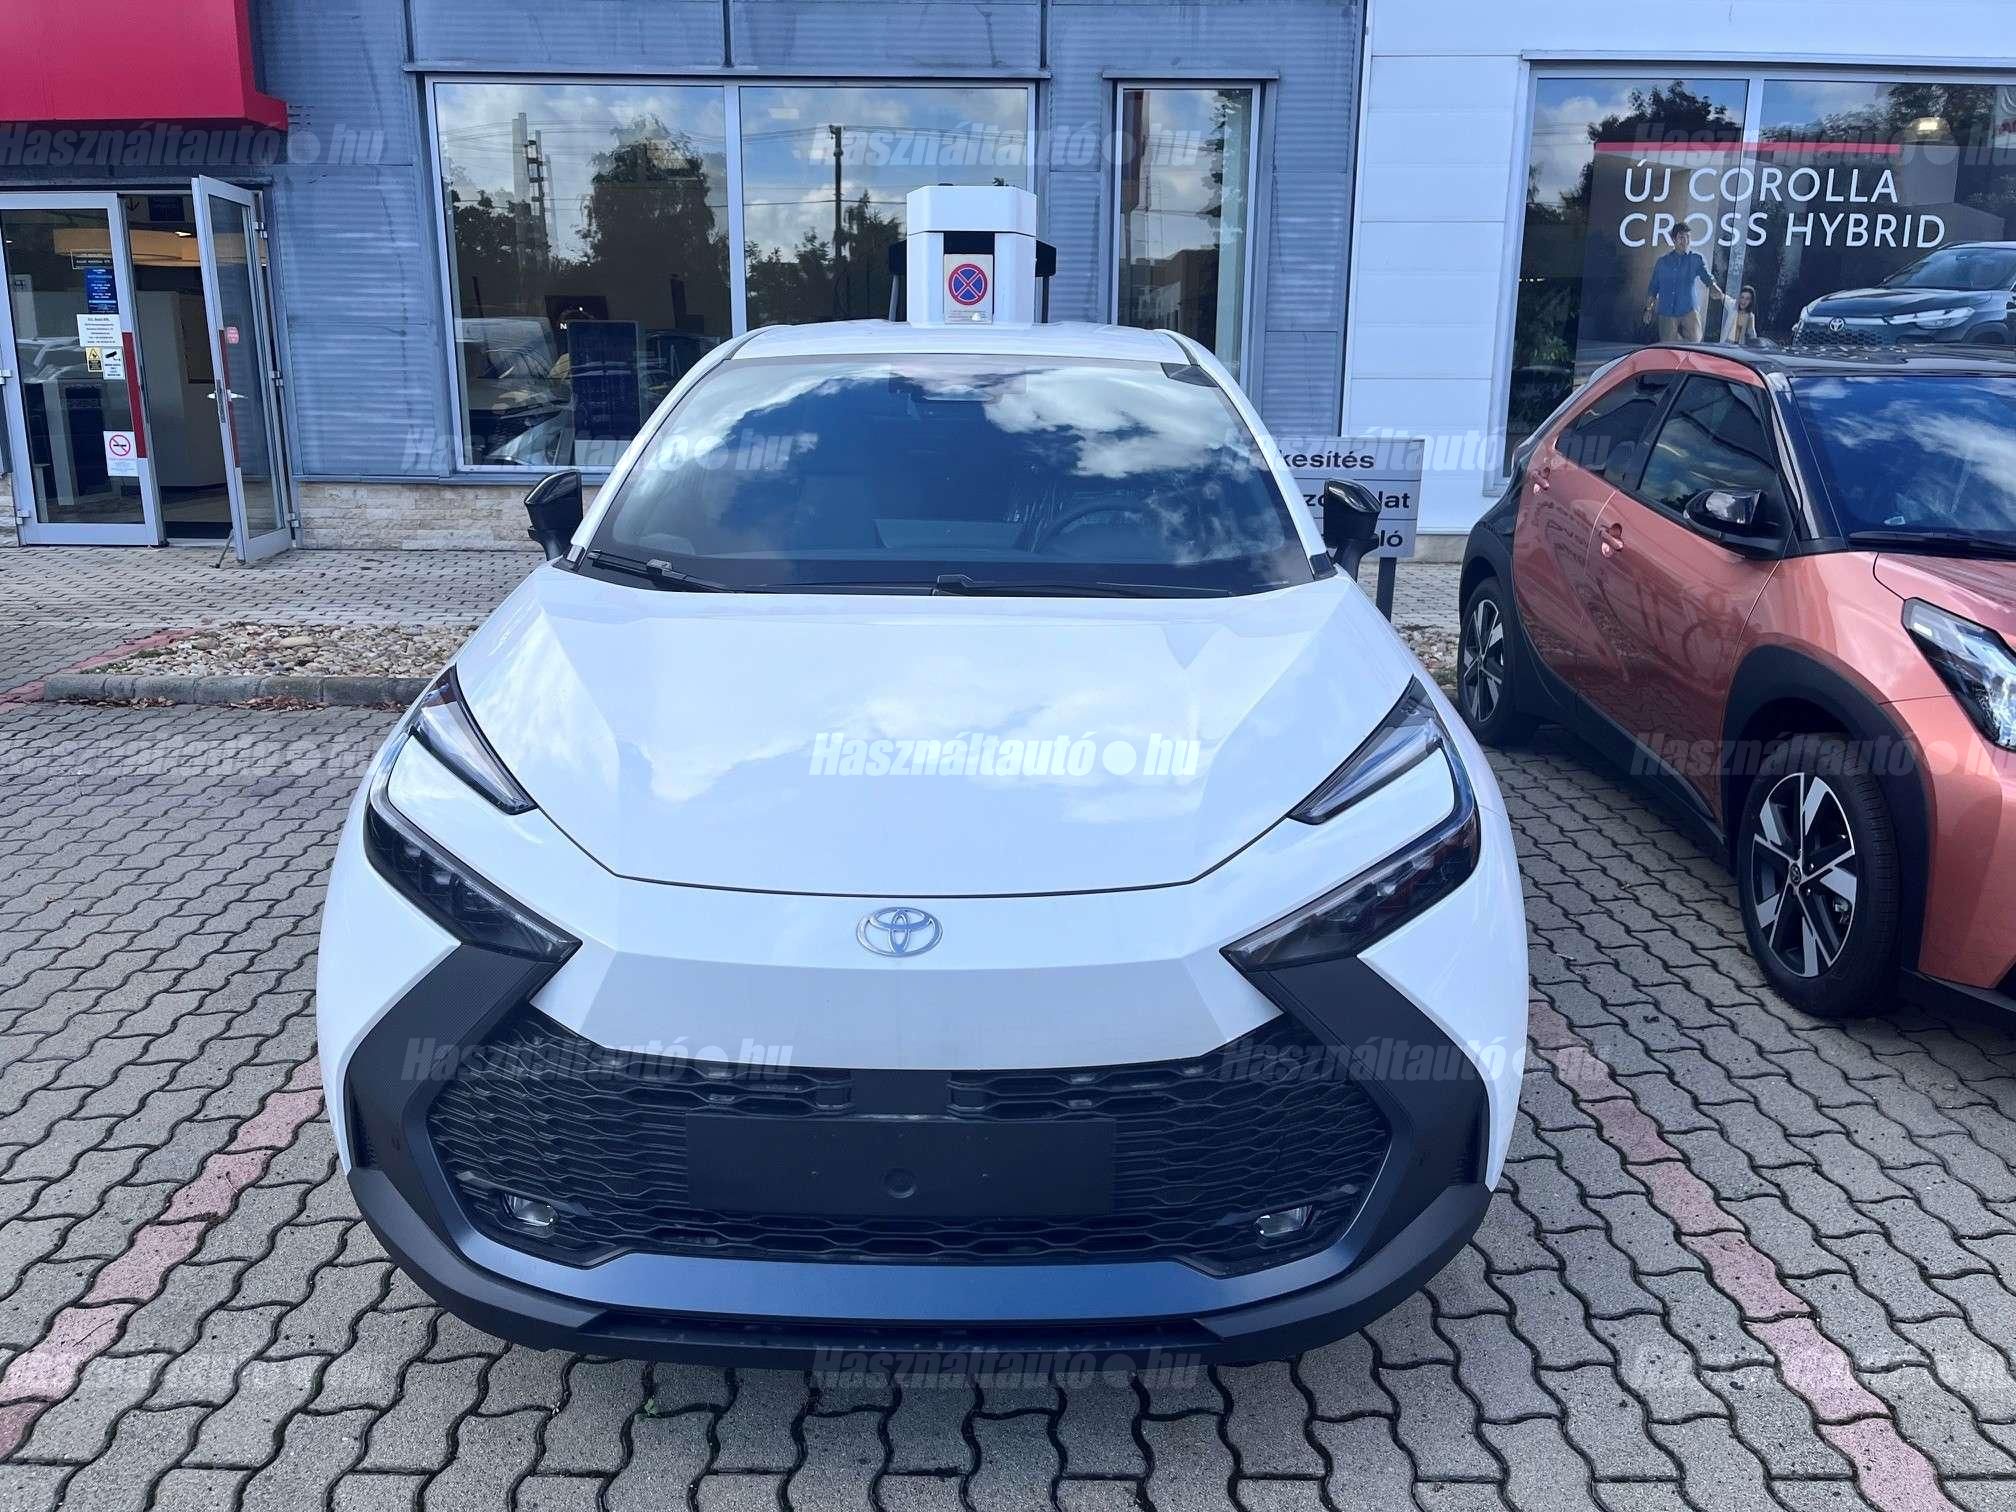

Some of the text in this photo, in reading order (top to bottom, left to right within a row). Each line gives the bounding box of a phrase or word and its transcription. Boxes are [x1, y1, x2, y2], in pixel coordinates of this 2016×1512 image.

[1624, 158, 1899, 203] ÚJ COROLLA
[1619, 212, 1946, 248] CROSS HYBRID
